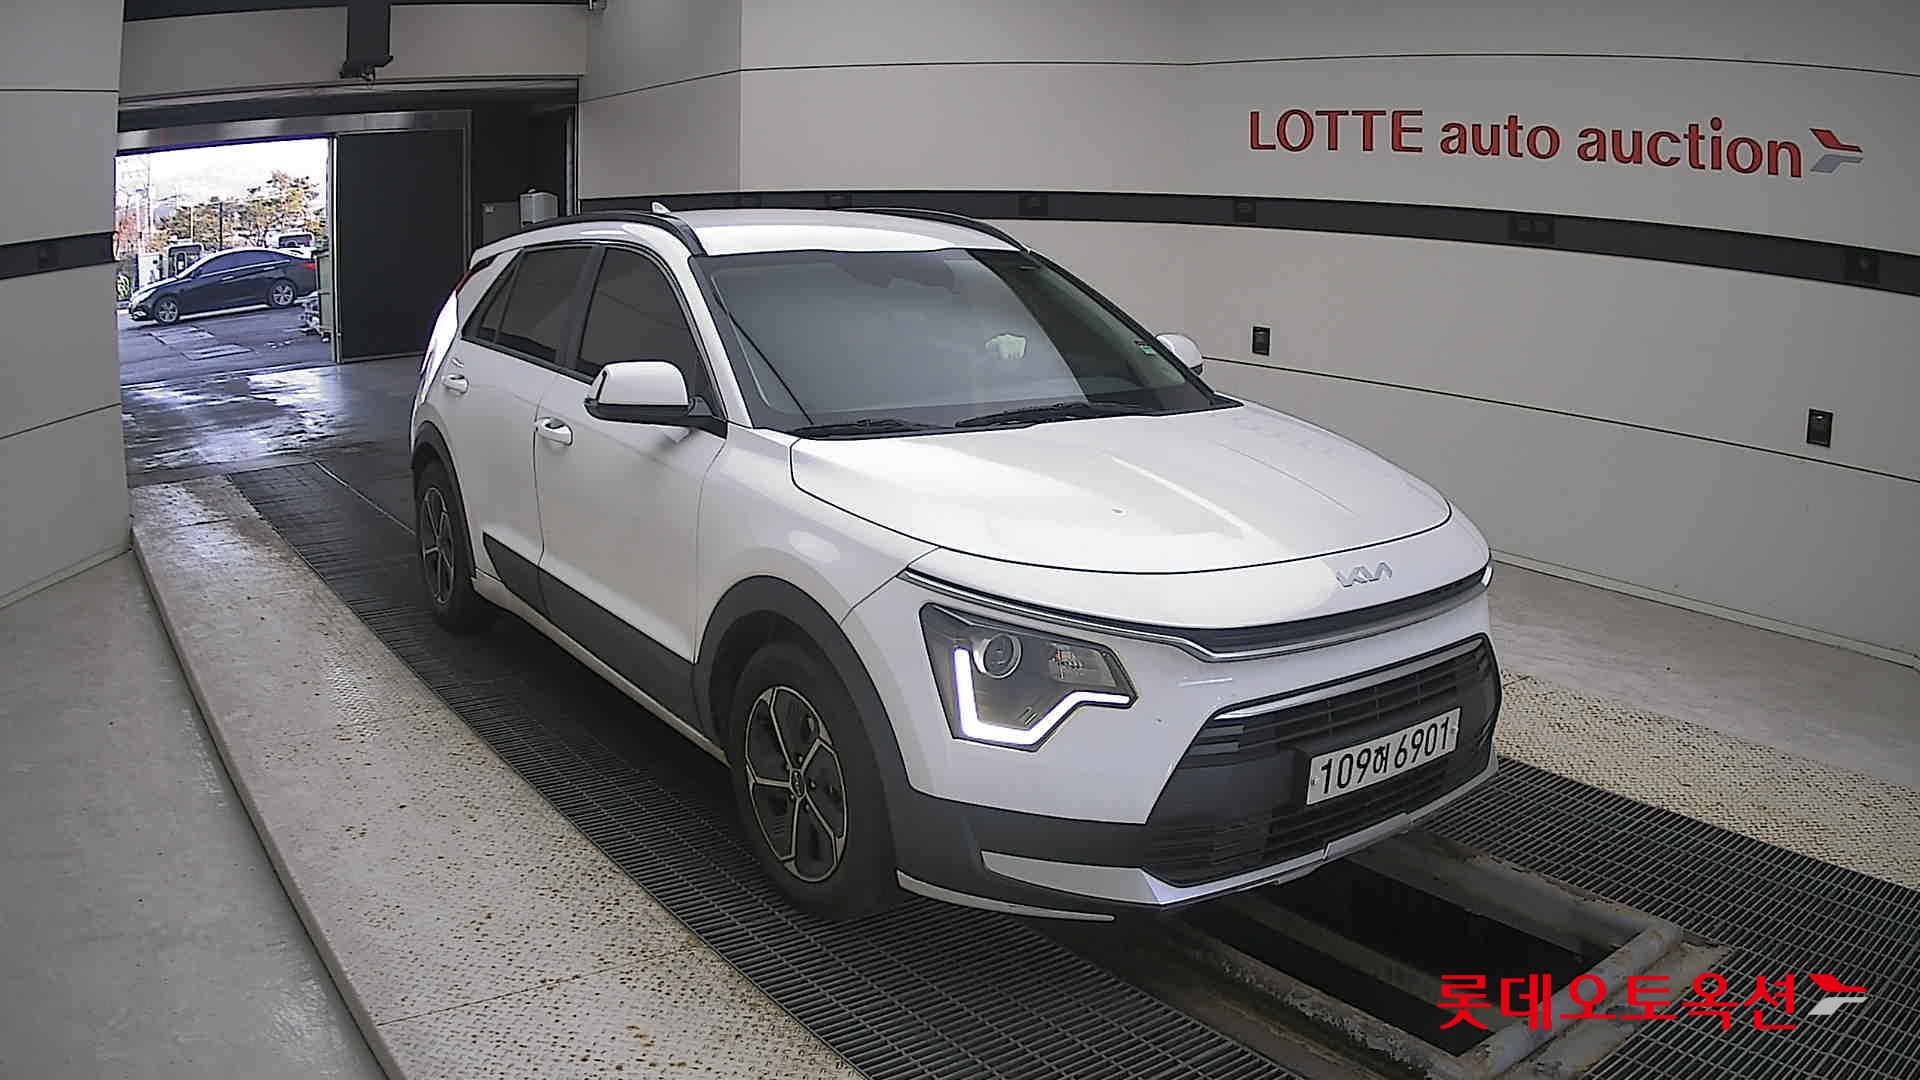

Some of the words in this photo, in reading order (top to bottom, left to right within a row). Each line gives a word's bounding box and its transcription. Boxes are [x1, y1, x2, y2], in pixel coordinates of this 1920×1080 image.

[1249, 109, 1423, 152] LOTTE
[1439, 115, 1560, 158] auto
[1576, 117, 1802, 177] auction
